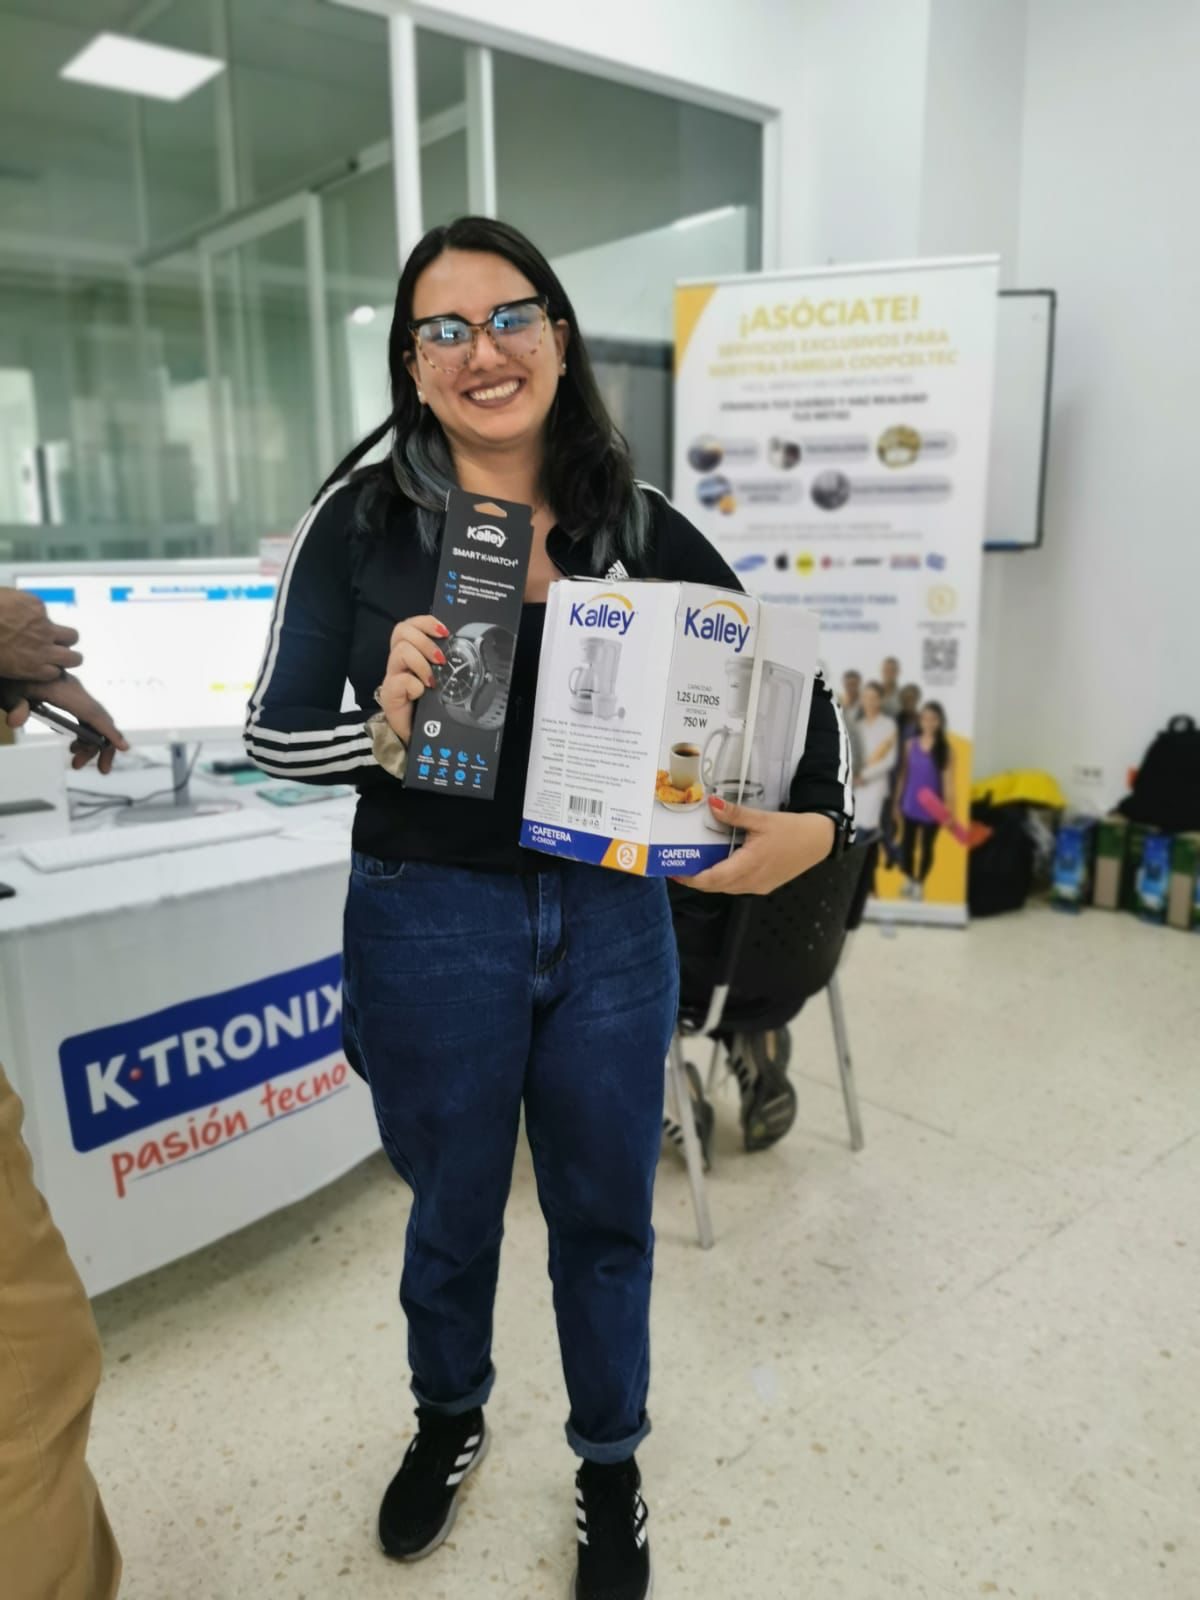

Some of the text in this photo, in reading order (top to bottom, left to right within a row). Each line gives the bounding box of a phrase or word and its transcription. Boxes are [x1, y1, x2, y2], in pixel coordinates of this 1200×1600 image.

[739, 294, 920, 337] ¡ASÓCIATE!
[467, 525, 506, 548] Kalley
[452, 547, 481, 561] SMART
[569, 602, 635, 635] Kalley
[684, 607, 751, 652] Kalley
[676, 690, 720, 706] 1.25 LITROS
[683, 716, 708, 728] 750 W
[532, 825, 572, 843] CAFETERA
[662, 848, 701, 859] CAFETERA
[111, 1106, 248, 1199] pasión
